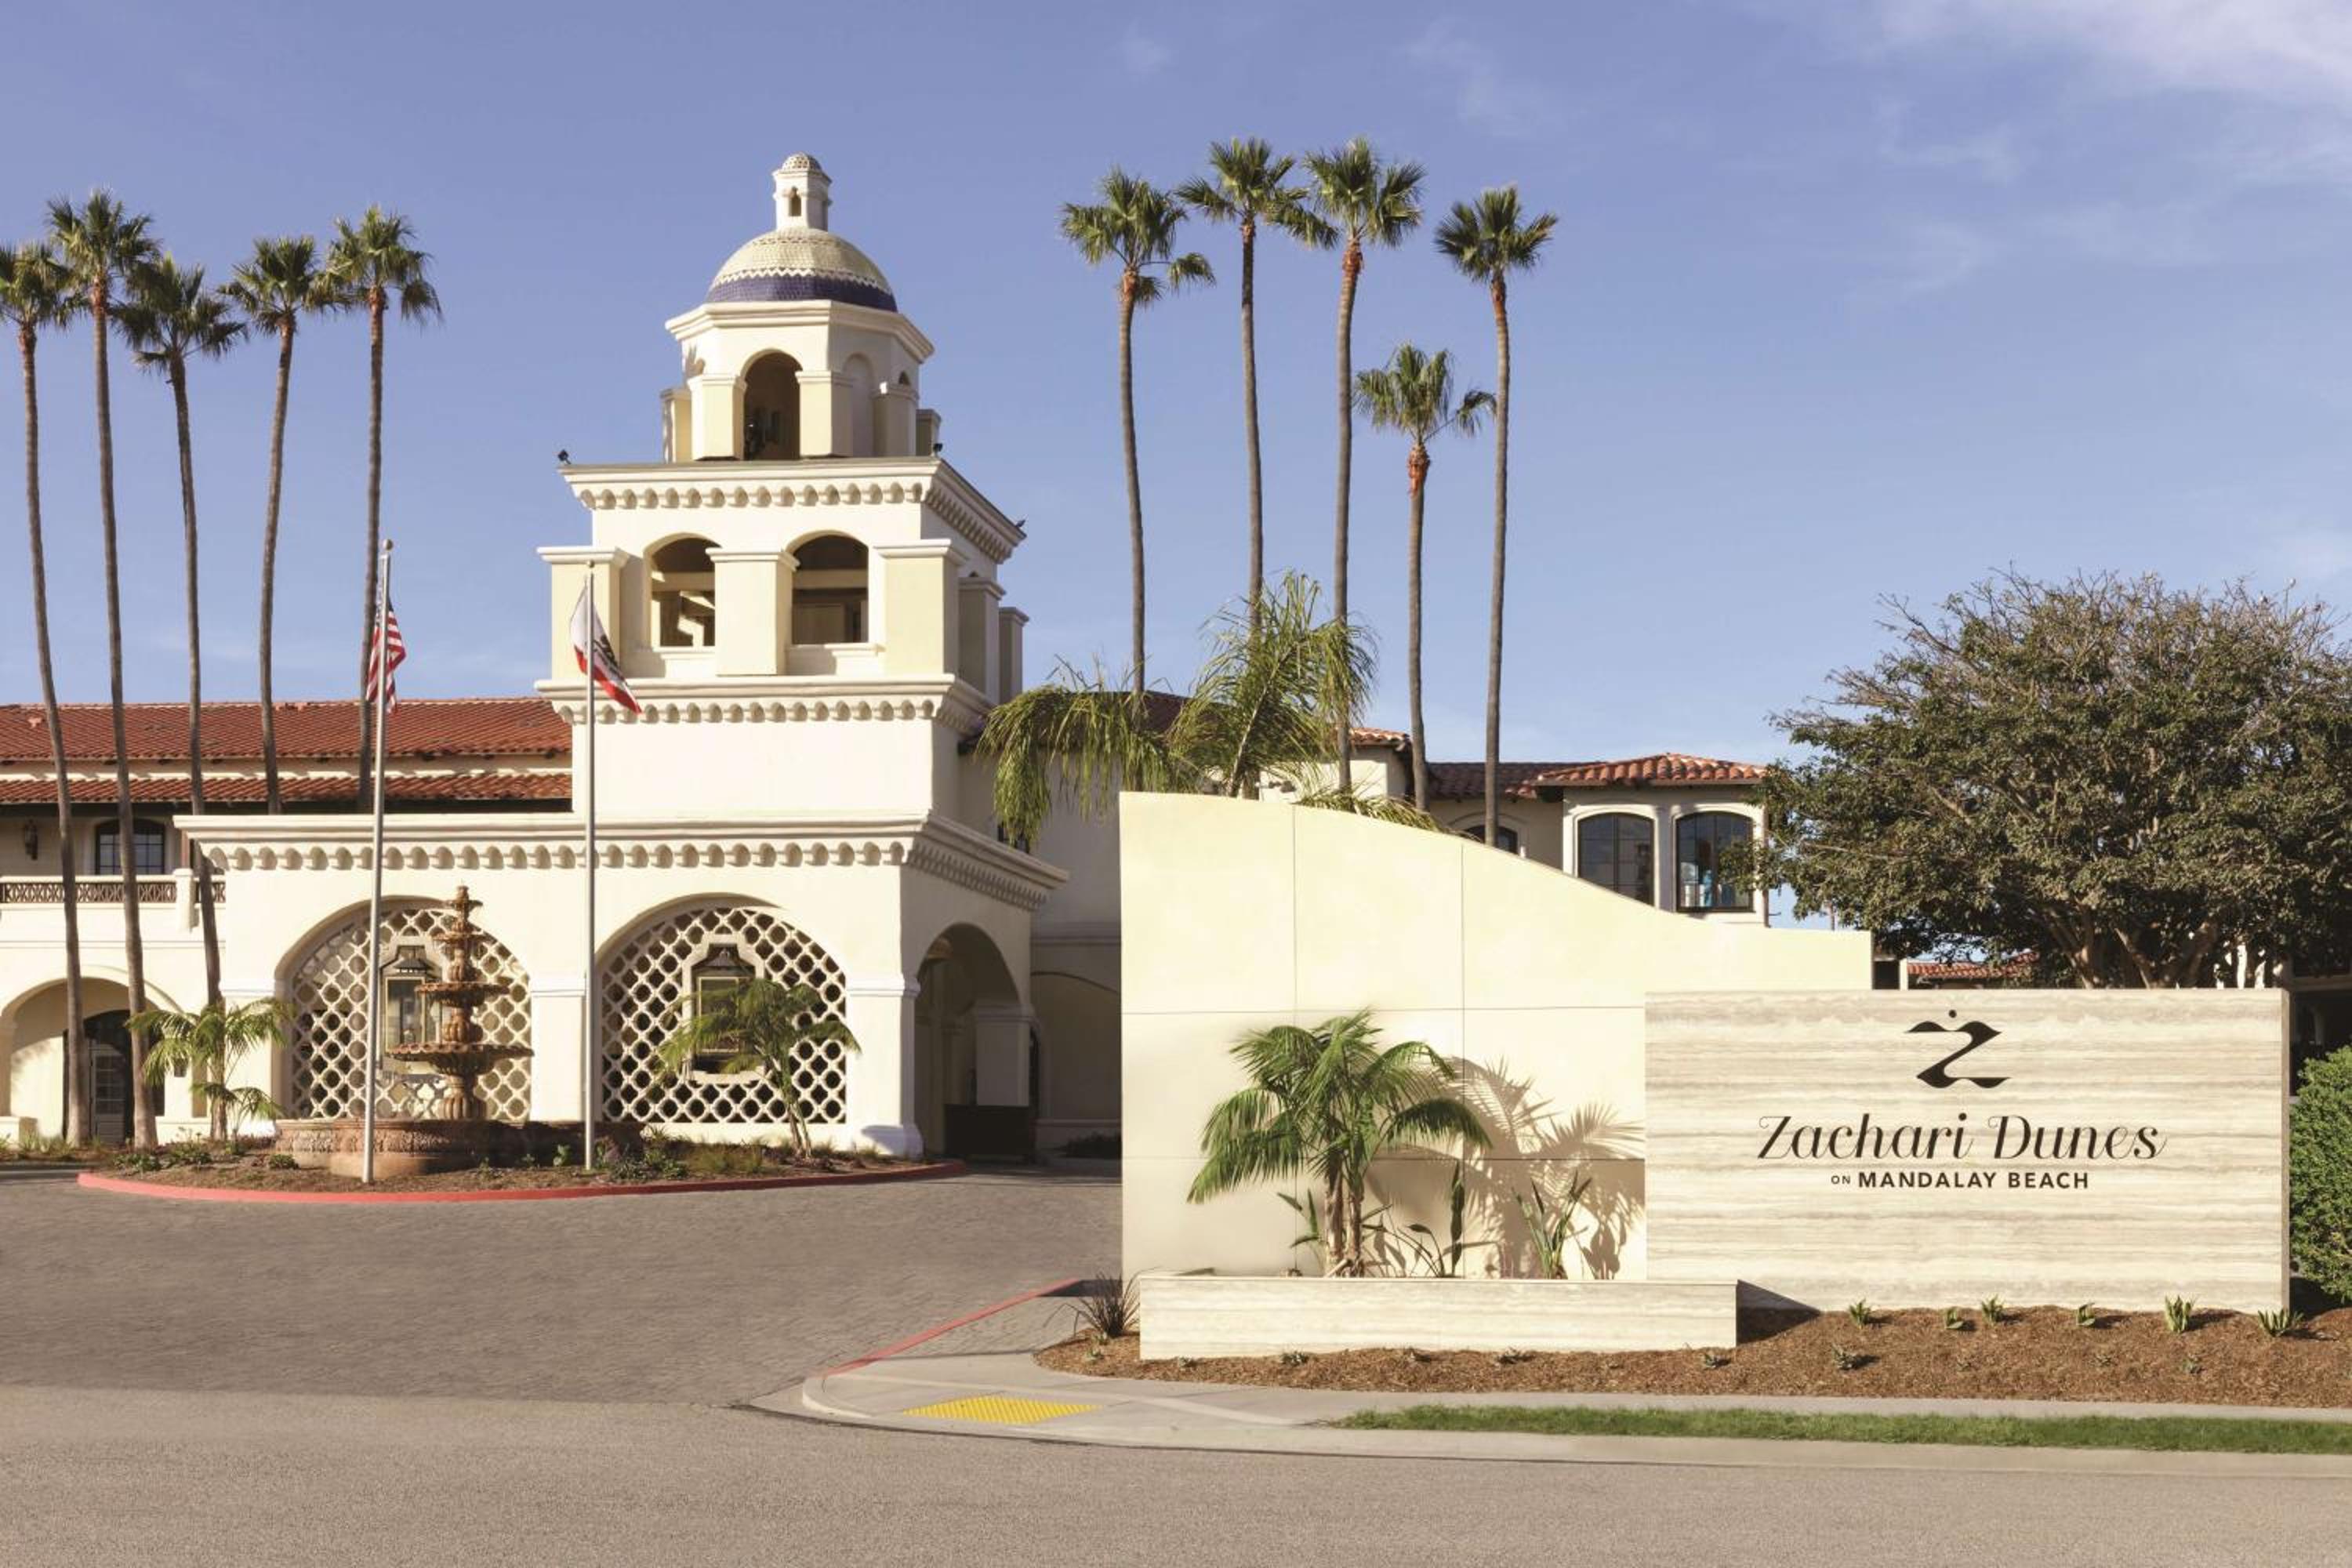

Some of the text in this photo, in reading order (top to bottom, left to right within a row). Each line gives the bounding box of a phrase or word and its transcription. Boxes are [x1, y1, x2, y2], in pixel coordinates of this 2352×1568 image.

[1757, 1112, 2167, 1160] Zachari Dunes
[1831, 1171, 2089, 1189] ON MANDALAY BEACH
